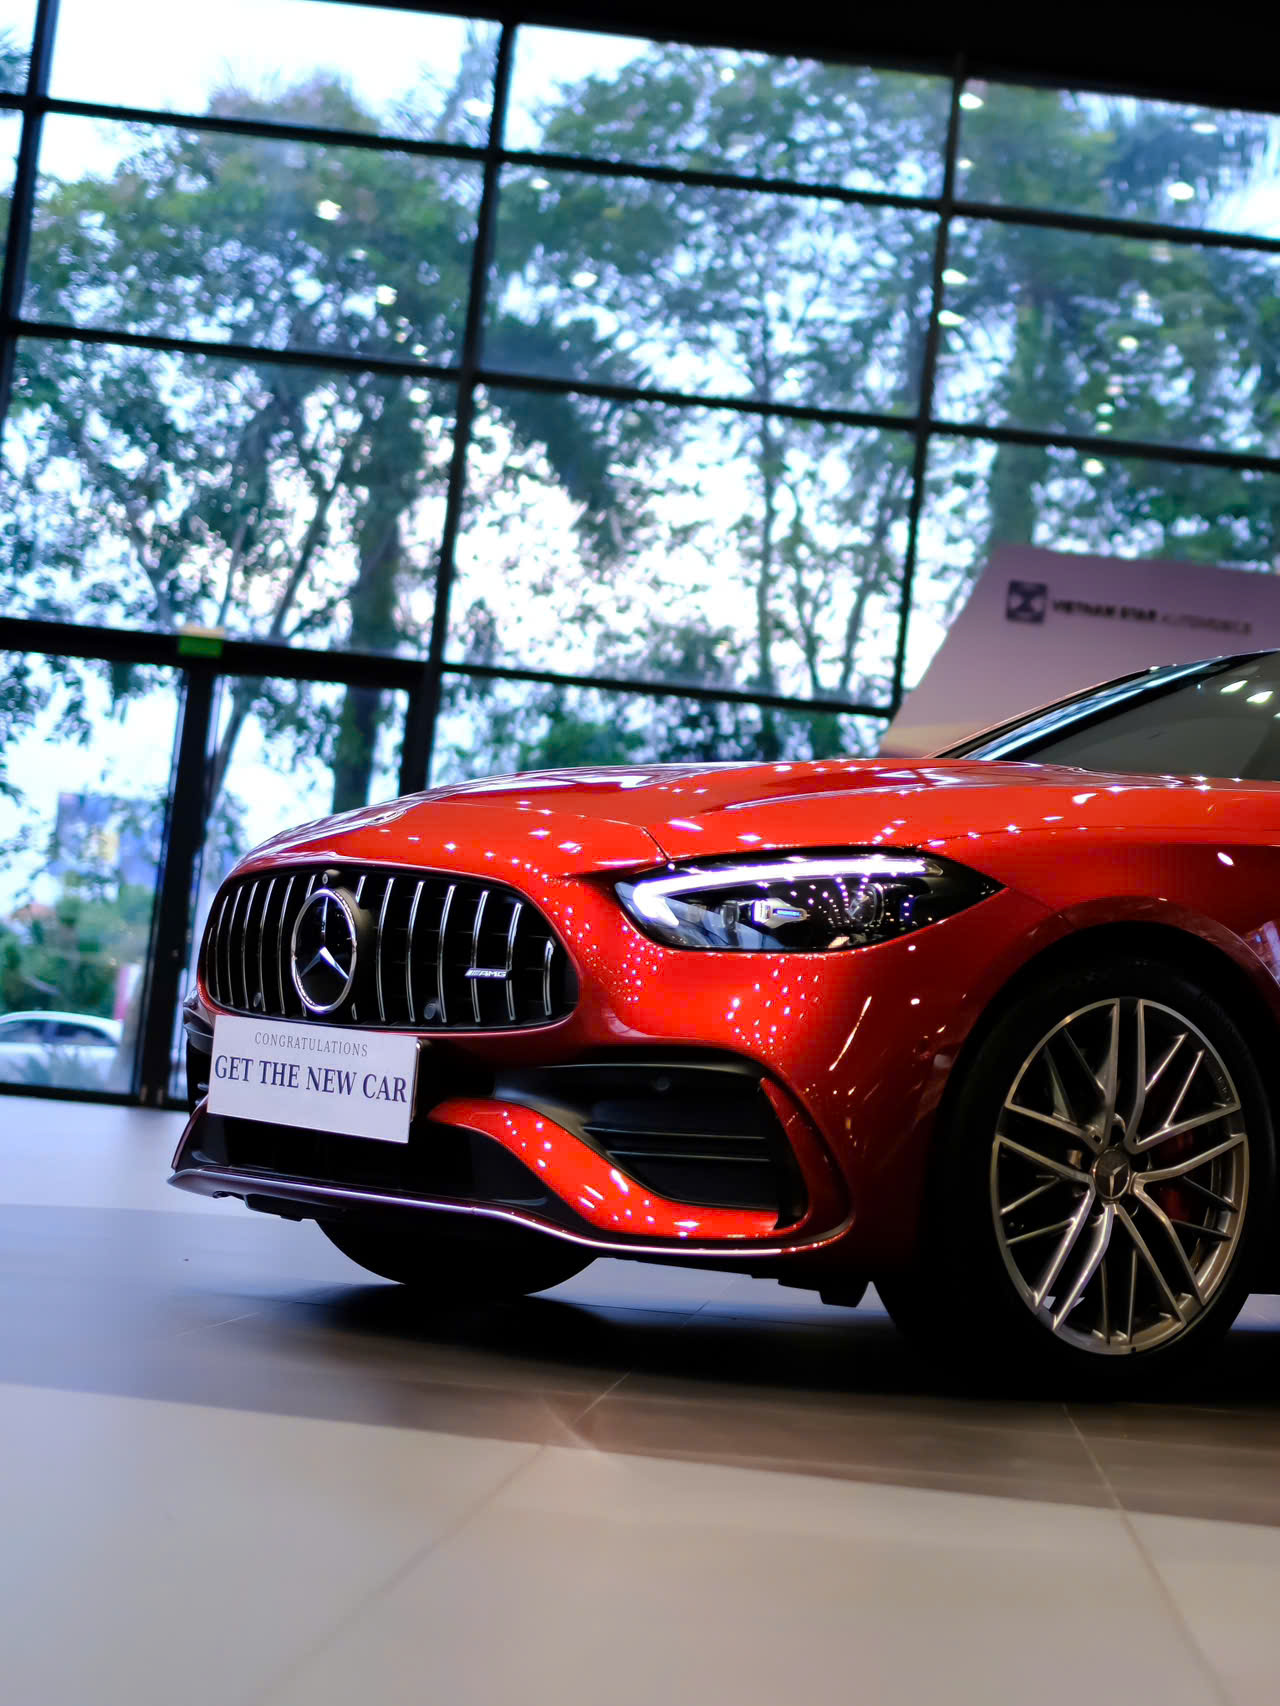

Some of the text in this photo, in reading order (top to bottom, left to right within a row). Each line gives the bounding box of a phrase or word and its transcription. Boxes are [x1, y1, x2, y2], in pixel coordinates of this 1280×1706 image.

[254, 1031, 369, 1057] CONGRATULATIONS
[214, 1054, 408, 1103] GET THE NEW CAR
